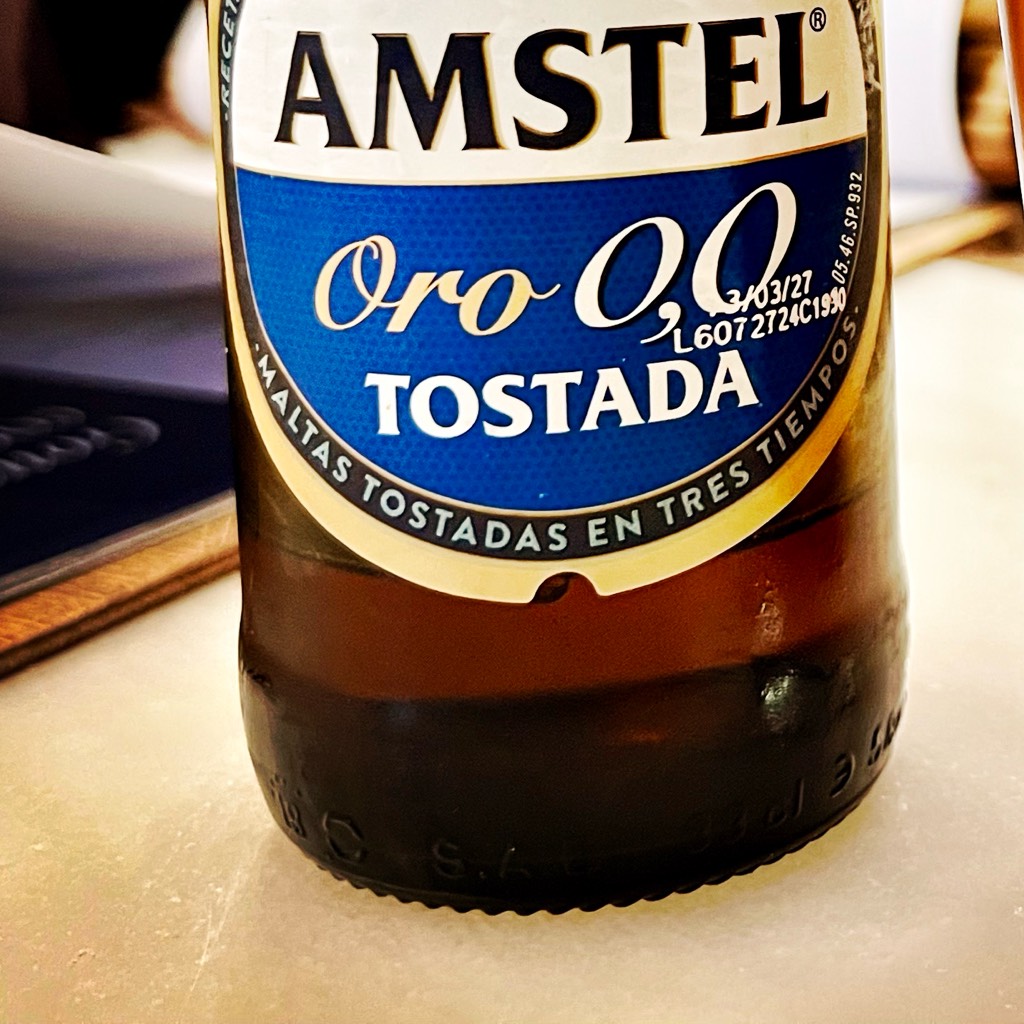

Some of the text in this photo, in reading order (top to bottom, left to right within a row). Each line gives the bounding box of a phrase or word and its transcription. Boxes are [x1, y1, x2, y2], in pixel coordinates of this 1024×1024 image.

[313, 181, 798, 344] Oro 0,0
[831, 171, 863, 285] 05.46.SP.932
[257, 314, 857, 553] MALTAS TOSTADAS EN TRES TIEMPOS
[363, 349, 760, 439] TOSTADA
